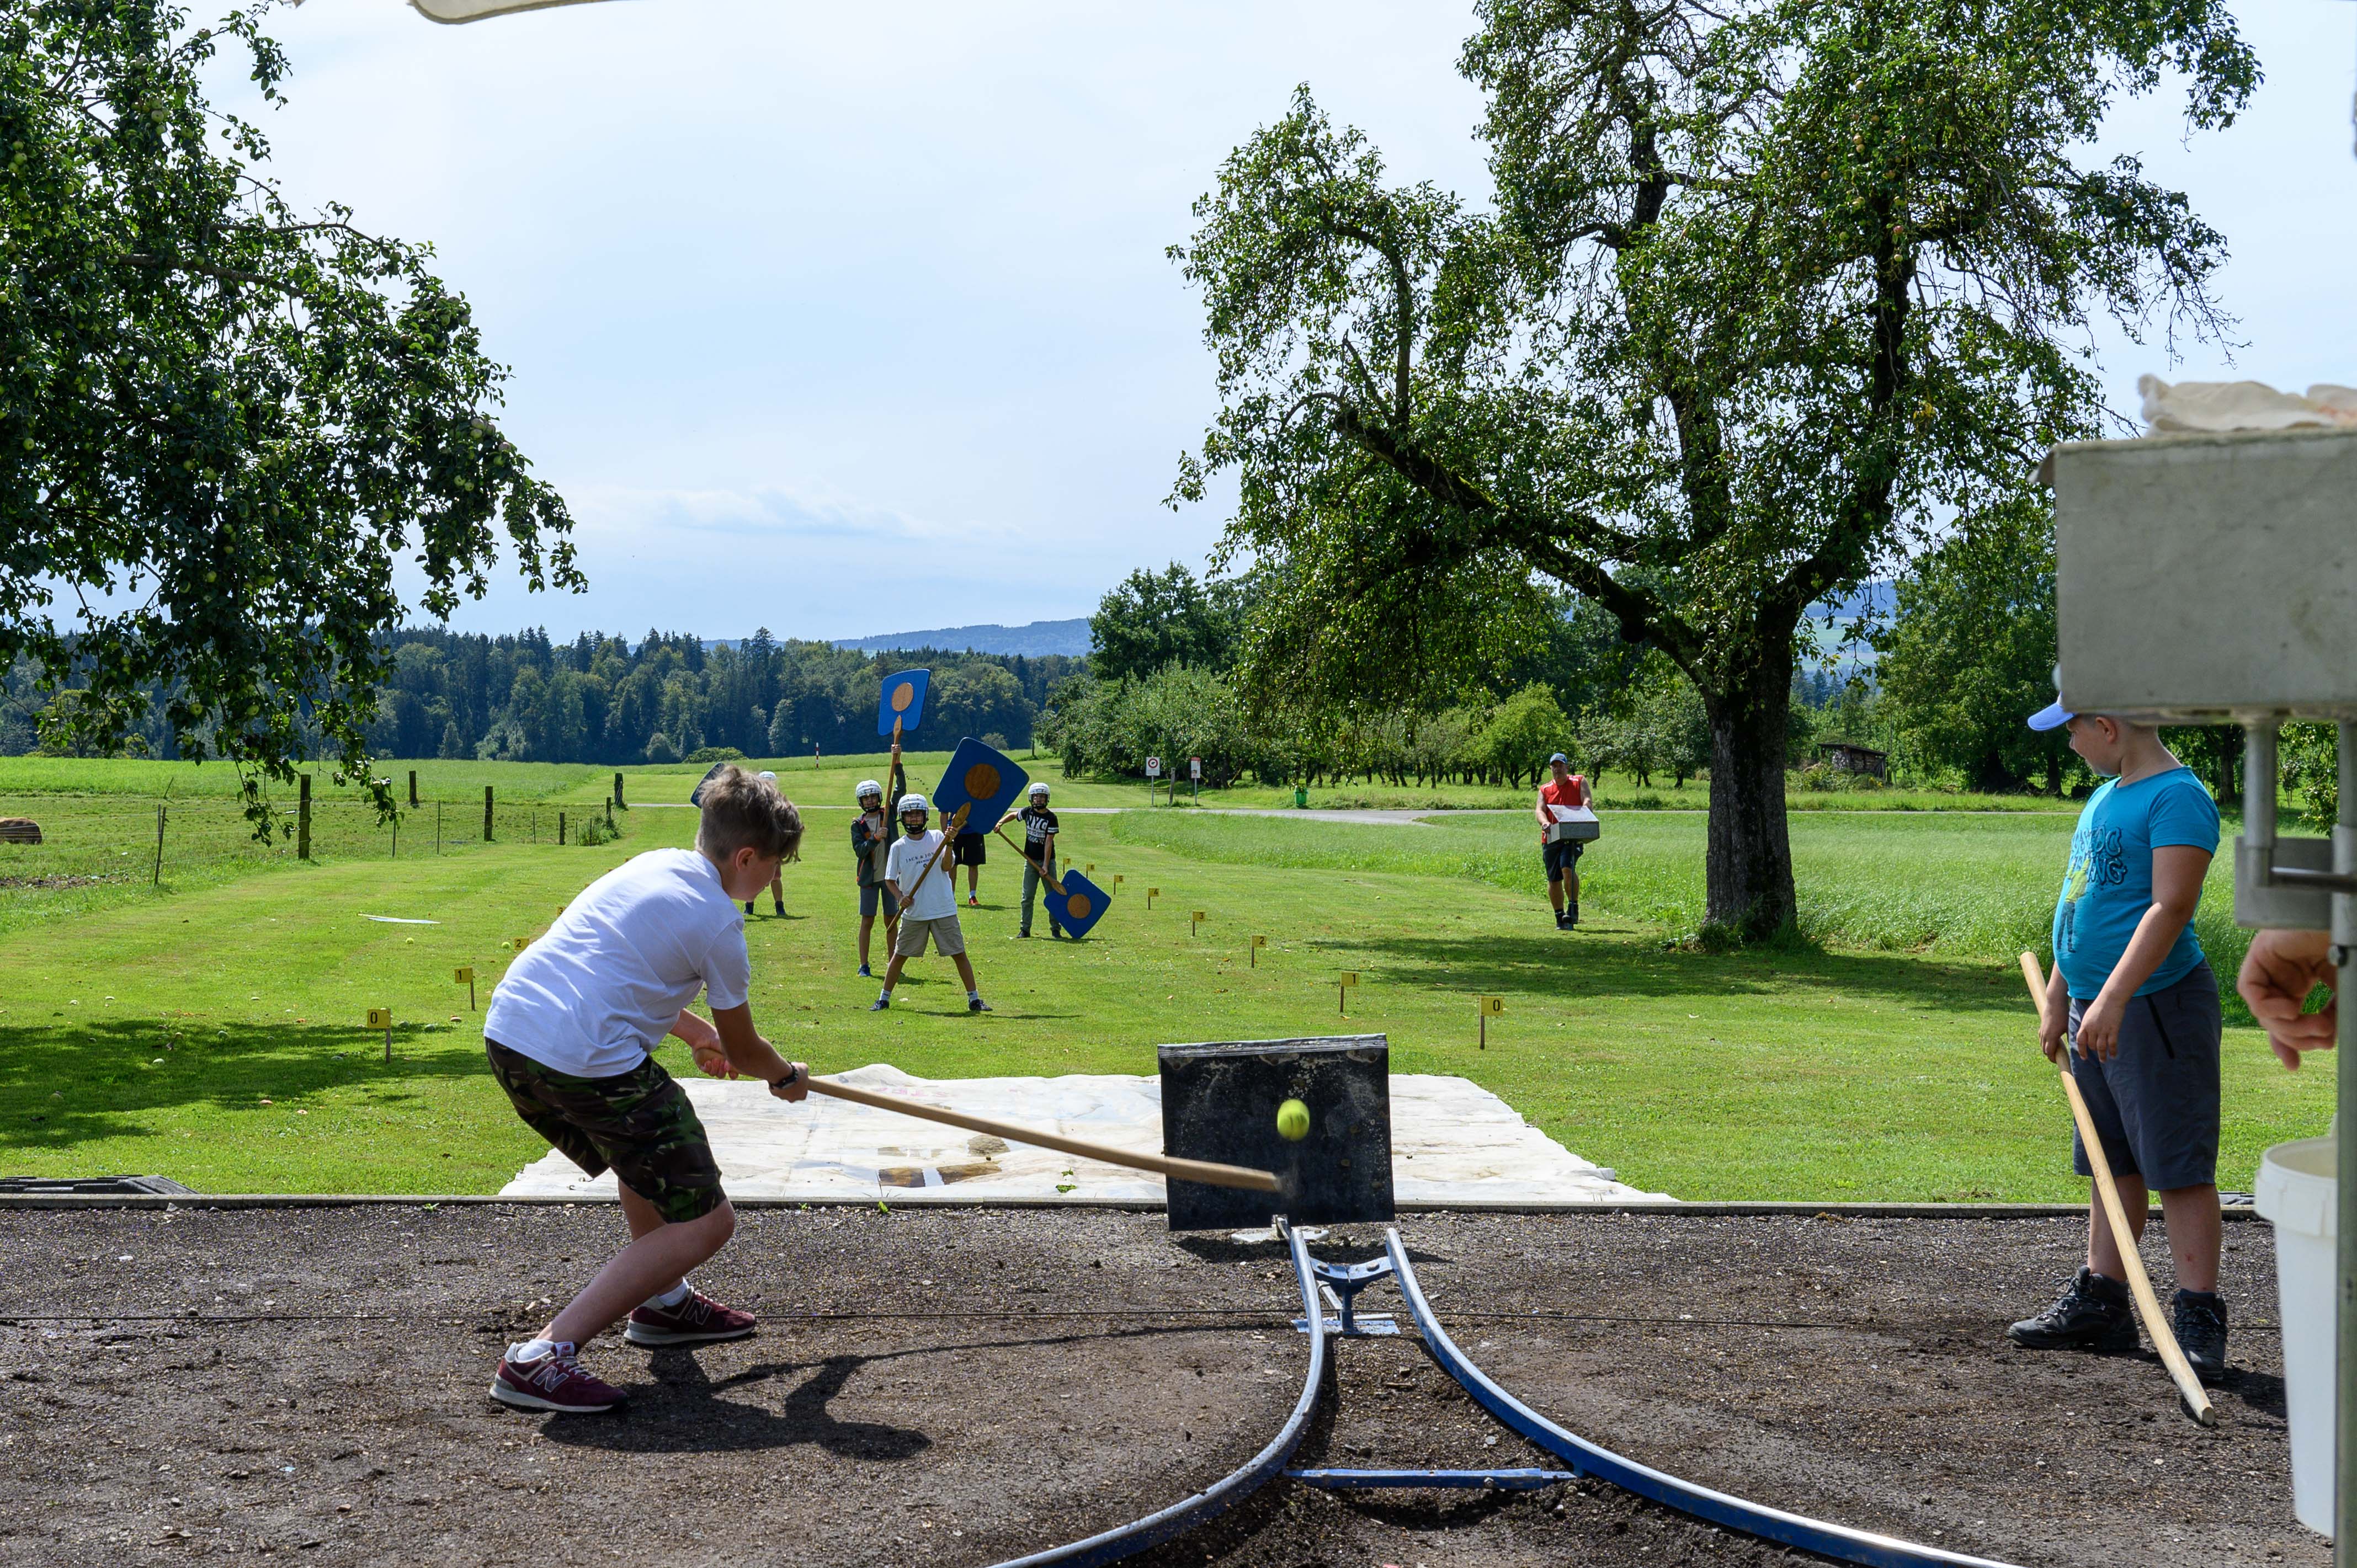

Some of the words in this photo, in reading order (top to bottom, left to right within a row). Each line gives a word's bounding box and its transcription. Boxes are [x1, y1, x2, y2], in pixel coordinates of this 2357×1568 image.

[516, 939, 521, 947] 2
[1259, 936, 1264, 945] 2
[457, 970, 461, 980] 1
[1352, 974, 1355, 984] 1
[1493, 999, 1500, 1011] 0
[370, 1011, 377, 1024] 0
[685, 1299, 712, 1325] N
[533, 1365, 569, 1393] N
